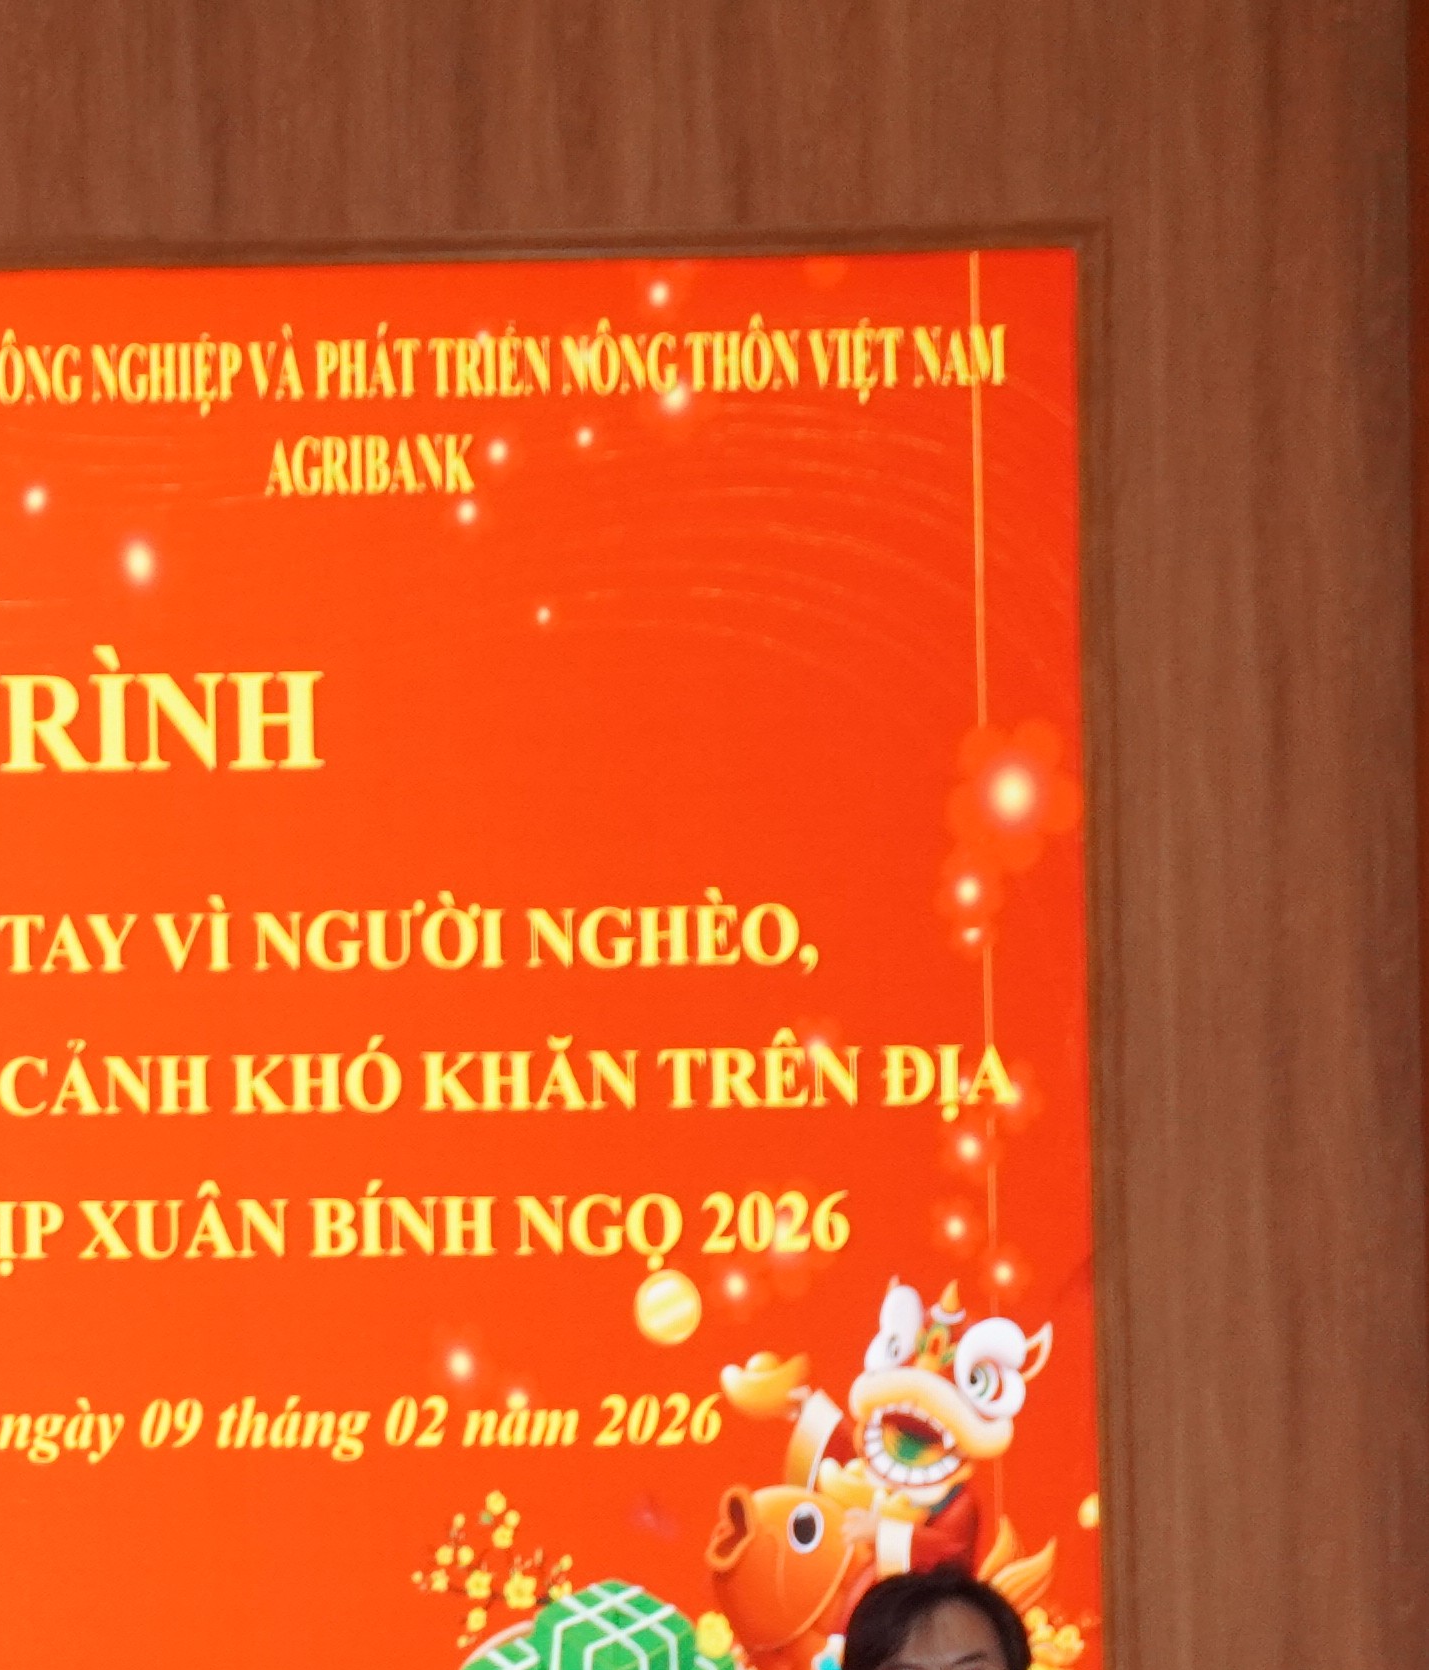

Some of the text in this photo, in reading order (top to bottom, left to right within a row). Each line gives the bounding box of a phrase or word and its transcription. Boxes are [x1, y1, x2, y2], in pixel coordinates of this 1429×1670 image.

[90, 332, 243, 415] NGHIỆP
[247, 323, 305, 401] VÀ
[315, 321, 421, 400] PHÁT
[561, 316, 678, 397] NÔNG
[684, 312, 799, 393] THÔN
[808, 318, 904, 404] VIỆT
[913, 324, 1007, 388] NAM
[264, 433, 475, 497] AGRIBANK
[153, 894, 231, 973] VÌ
[253, 890, 504, 972] NGƯỜI
[526, 886, 819, 972] NGHÈO,
[232, 1034, 402, 1115] KHÓ
[422, 1035, 638, 1112] KHĂN
[657, 1027, 860, 1109] TRÊN
[881, 1043, 1022, 1123] ĐỊA
[78, 1179, 288, 1261] XUÂN
[309, 1178, 496, 1259] BÍNH
[514, 1193, 686, 1277] NGỌ
[701, 1190, 850, 1257] 2026
[138, 1397, 204, 1449] 09
[214, 1394, 371, 1462] tháng
[383, 1394, 449, 1448] 02
[460, 1388, 580, 1448] năm
[593, 1392, 724, 1447] 2026
